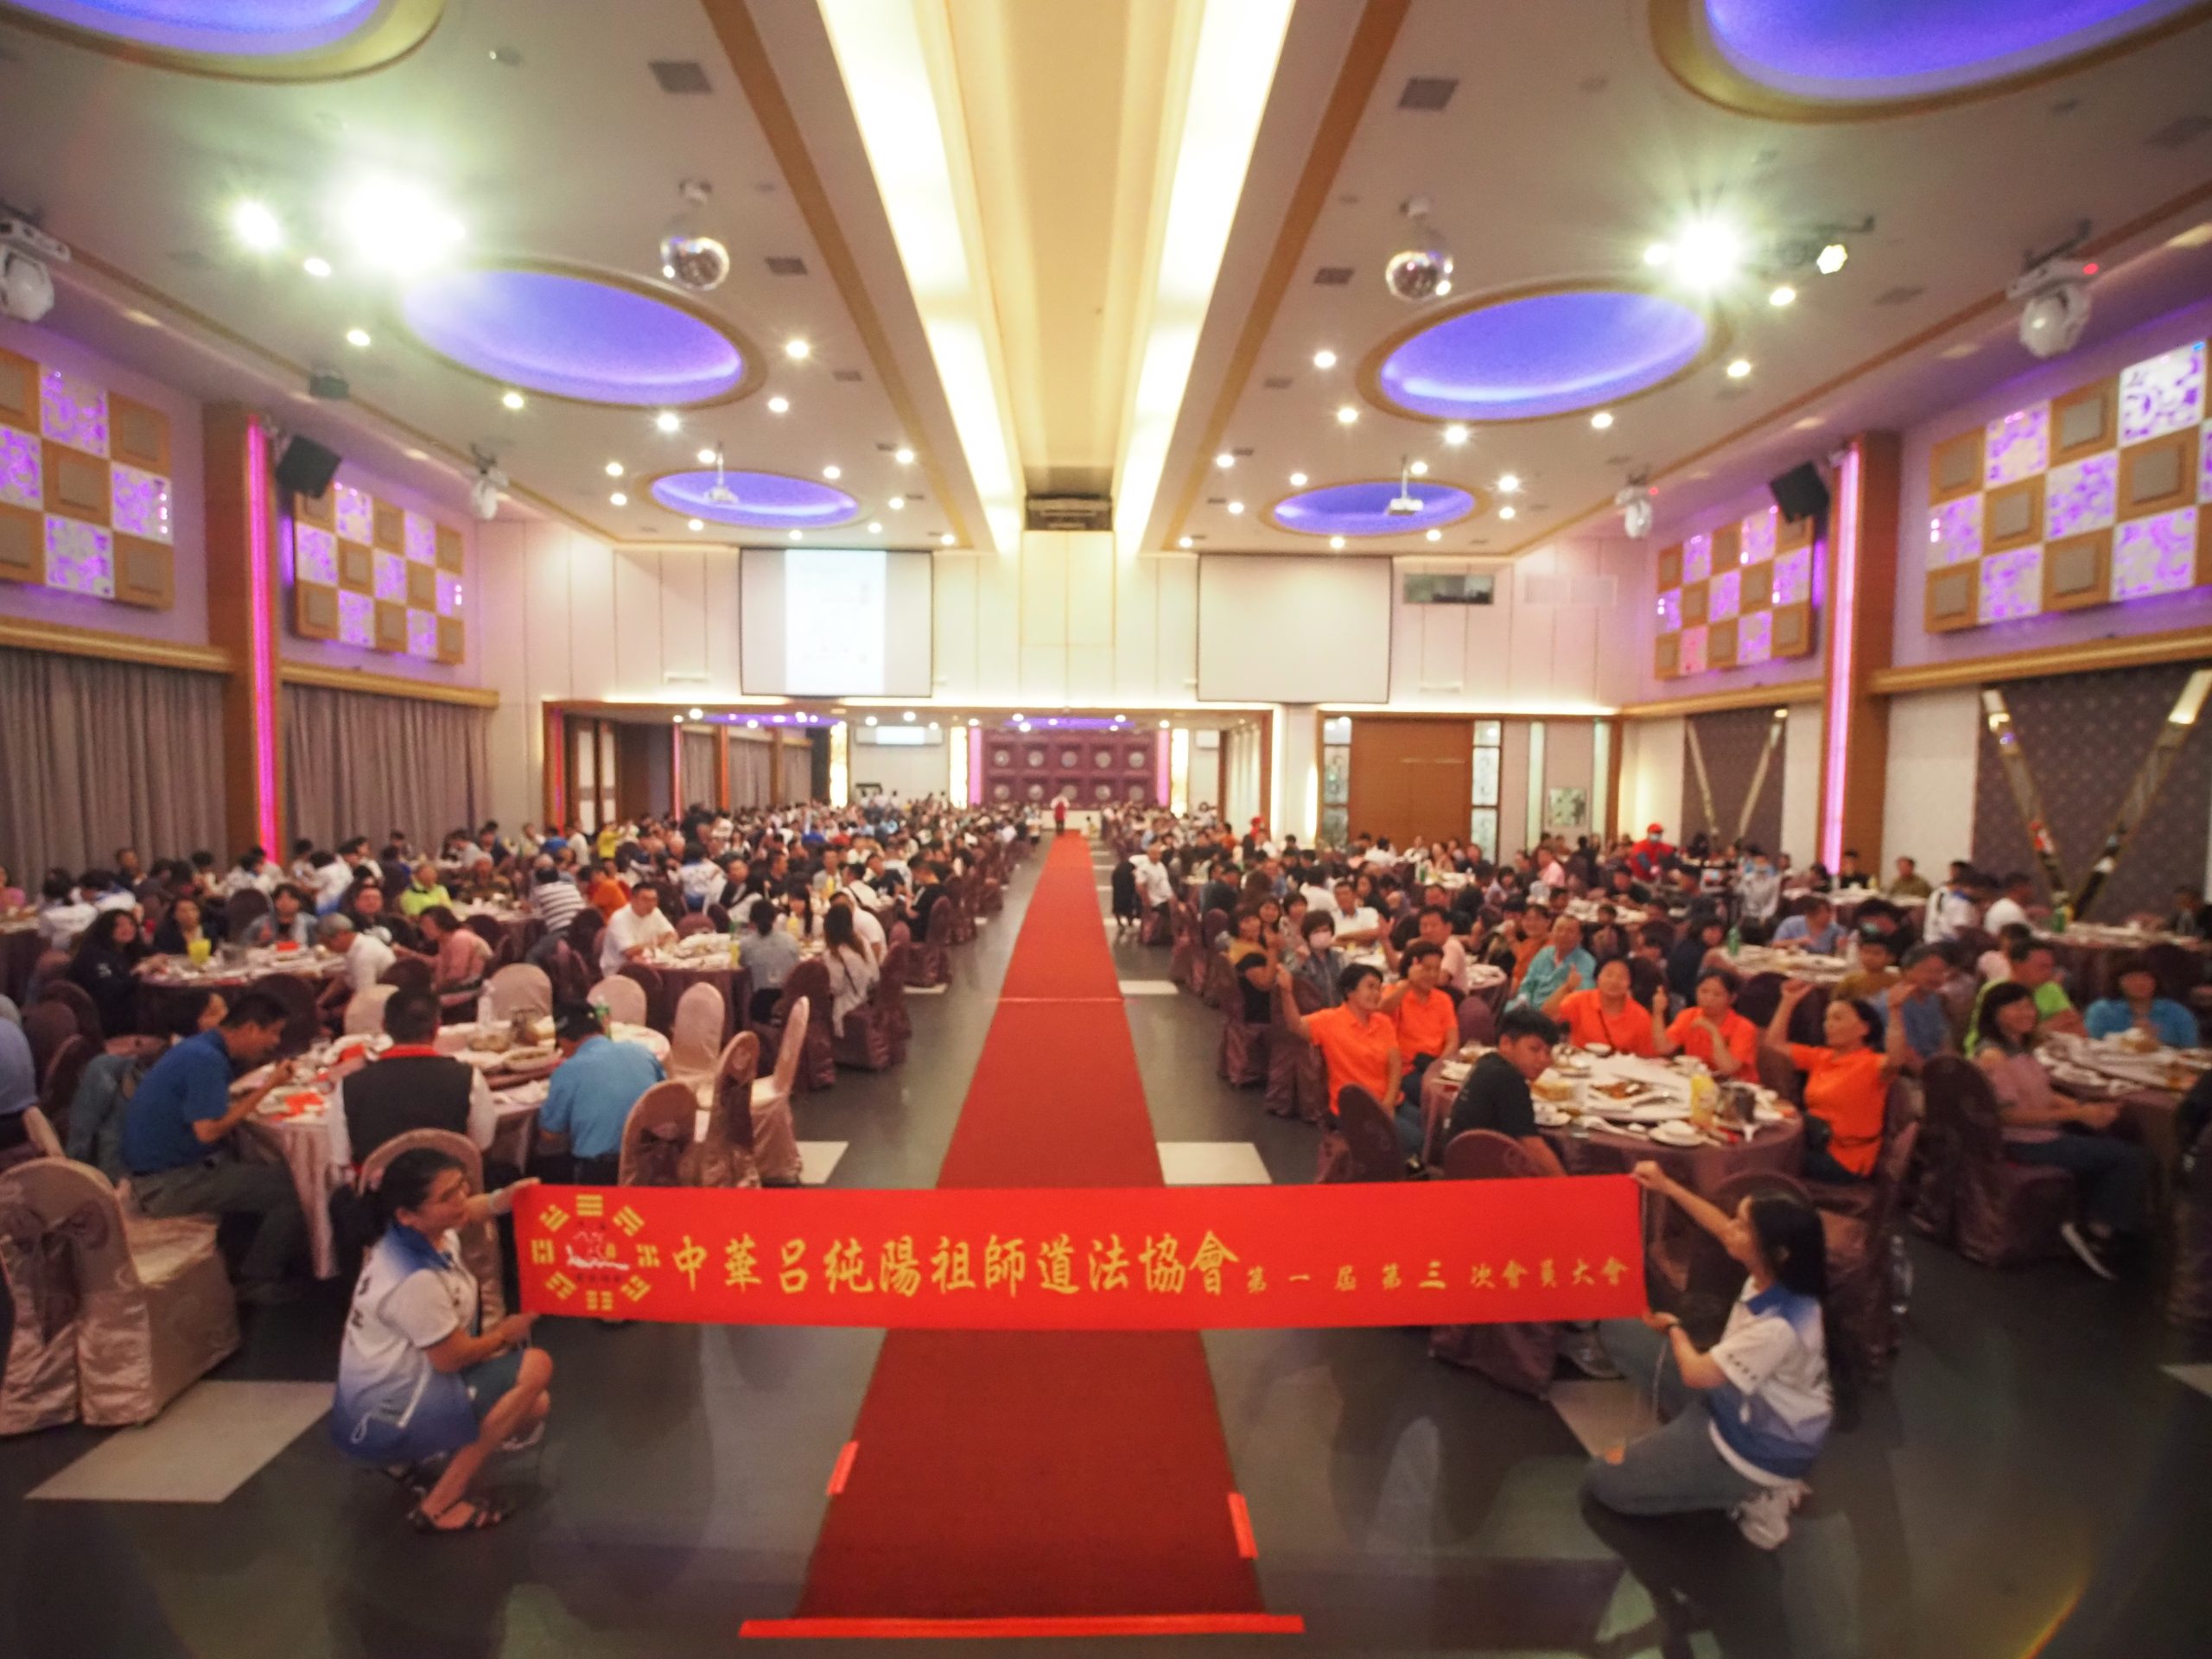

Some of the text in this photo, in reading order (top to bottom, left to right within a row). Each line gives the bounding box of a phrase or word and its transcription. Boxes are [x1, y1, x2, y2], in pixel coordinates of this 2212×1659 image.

[671, 1230, 1240, 1298] 中華呂純陽祖師道法協會
